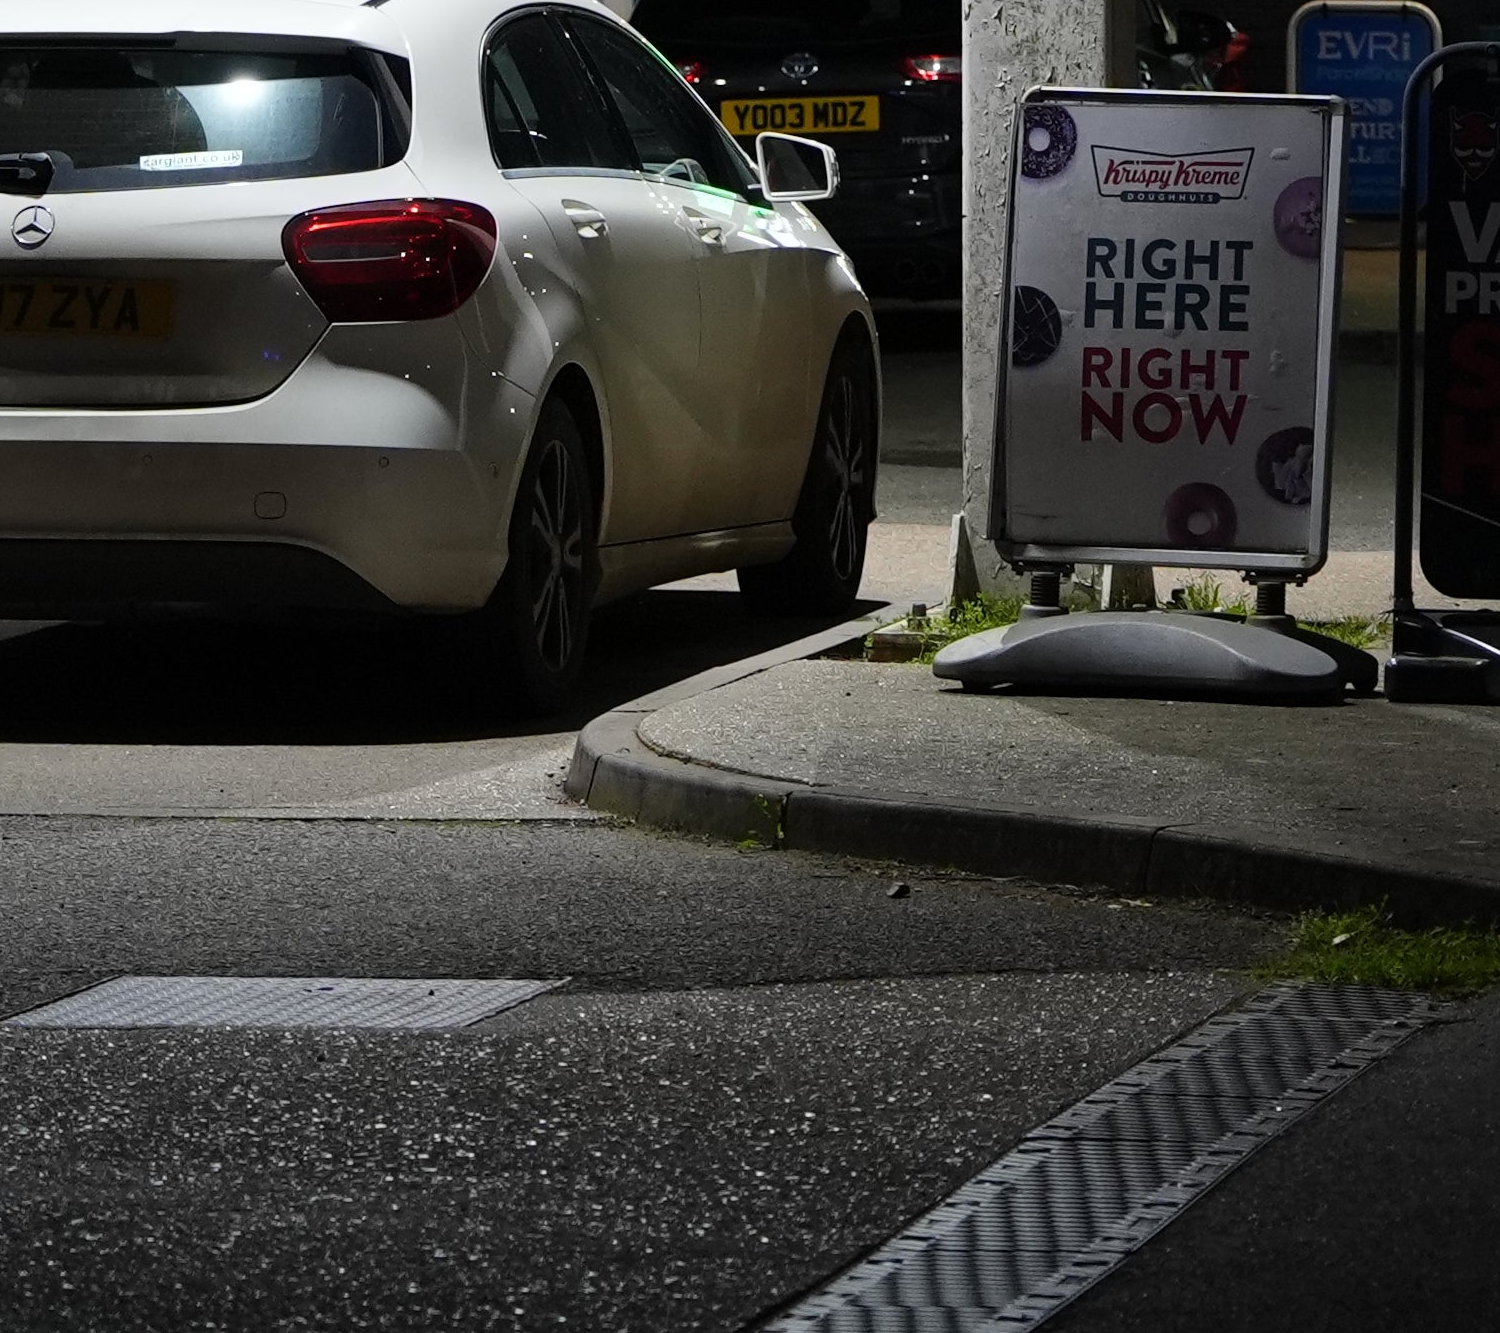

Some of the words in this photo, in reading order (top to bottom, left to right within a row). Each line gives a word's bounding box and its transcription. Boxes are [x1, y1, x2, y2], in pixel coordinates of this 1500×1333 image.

[812, 100, 867, 128] MDZ
[1349, 96, 1396, 117] END
[1103, 158, 1177, 190] Krispy
[1173, 159, 1244, 187] Kreme
[1126, 193, 1214, 202] DOUGHNUTS
[1085, 237, 1254, 281] RIGHT
[46, 285, 141, 332] ZYA
[1083, 282, 1250, 333] HERE
[1082, 347, 1250, 392] RIGHT
[1080, 391, 1248, 446] NOW
